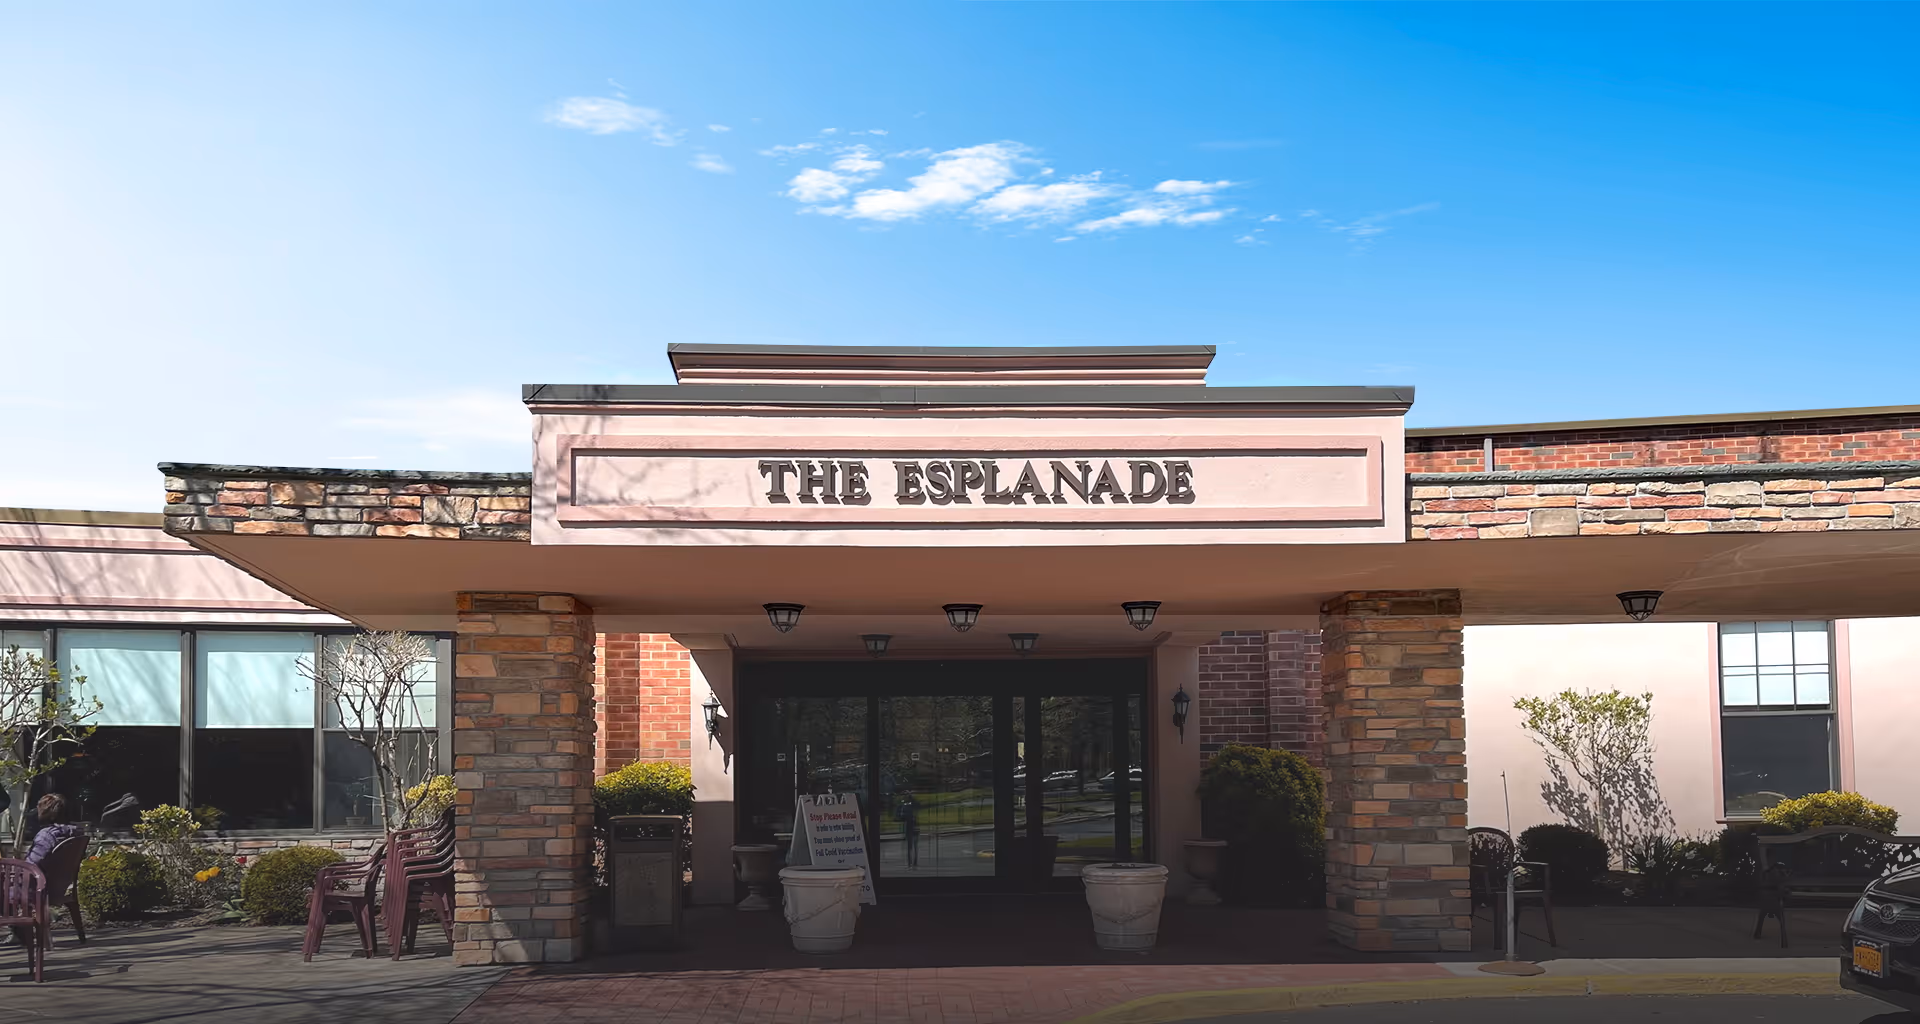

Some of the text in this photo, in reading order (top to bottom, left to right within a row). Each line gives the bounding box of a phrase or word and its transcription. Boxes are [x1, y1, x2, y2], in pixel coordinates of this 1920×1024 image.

[758, 460, 1196, 505] THE ESPLANADE
[810, 811, 857, 822] Stop Please Read
[825, 847, 838, 857] Covid
[838, 846, 864, 856] Vaccination
